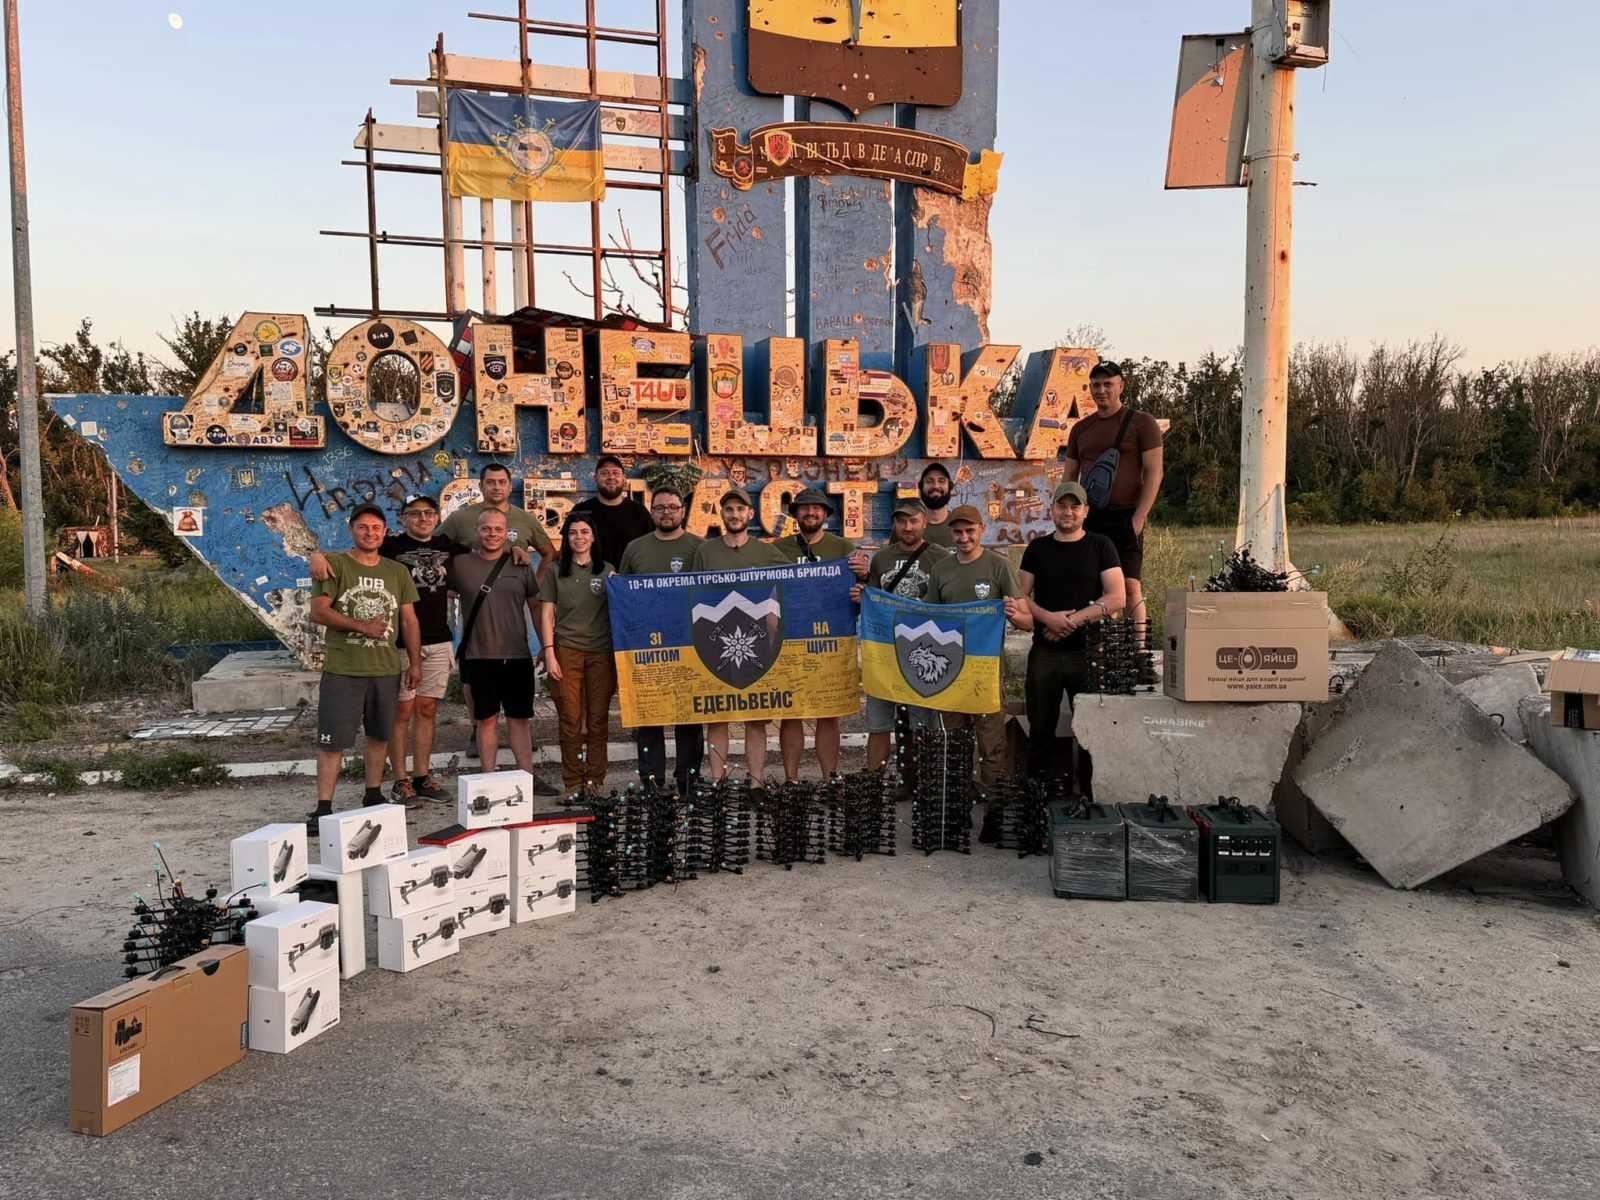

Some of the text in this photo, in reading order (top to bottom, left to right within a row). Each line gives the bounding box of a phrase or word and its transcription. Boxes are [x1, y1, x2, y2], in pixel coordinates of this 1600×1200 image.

[704, 206, 758, 271] Frida
[162, 311, 1100, 459] ДОНЕЦЬКА
[628, 565, 842, 591] 10-ТА ОКРЕМА ГІРСЬКО-ШТУРМОВА БРИГАДА
[650, 632, 662, 645] ЗІ
[813, 621, 830, 635] НА
[634, 649, 680, 665] ЩИТОМ
[807, 639, 839, 654] ЩИТІ
[693, 688, 793, 715] ЕДЕЛЬВЕЙС
